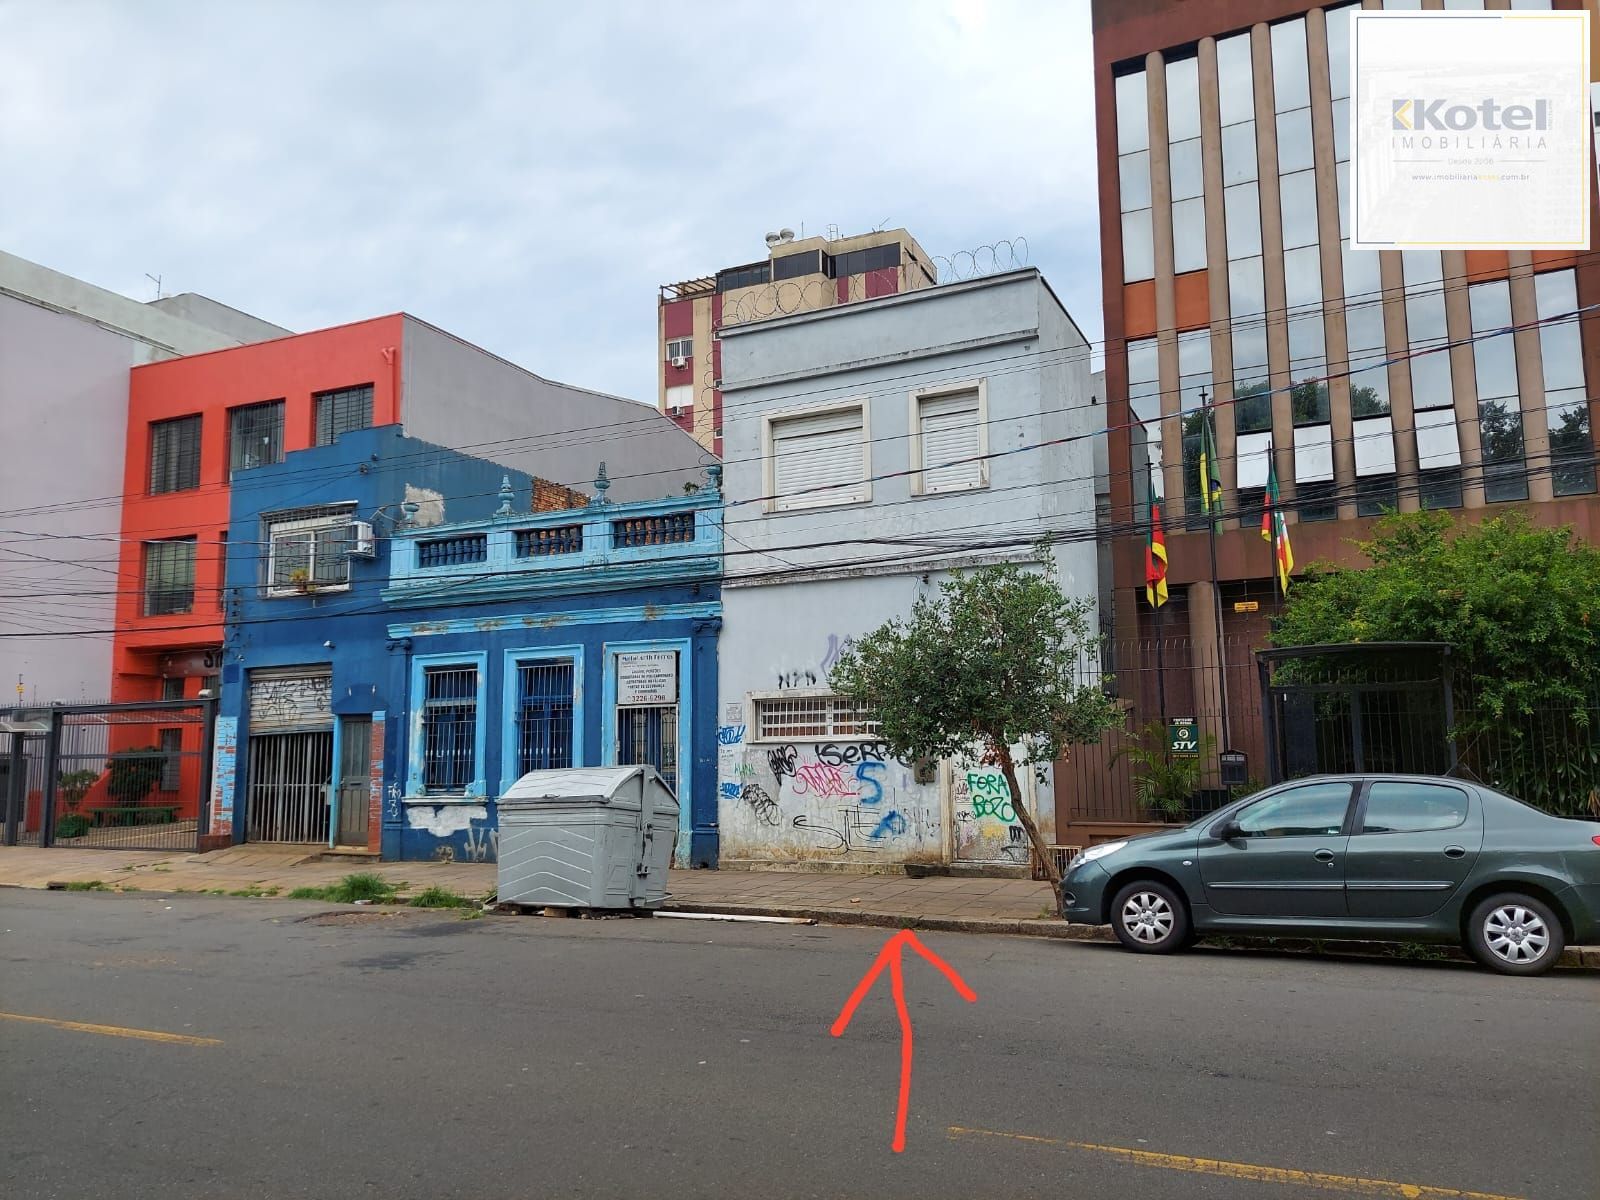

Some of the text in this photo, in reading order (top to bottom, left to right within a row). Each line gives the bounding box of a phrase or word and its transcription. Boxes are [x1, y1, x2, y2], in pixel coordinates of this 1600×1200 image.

[1171, 741, 1197, 750] STV
[967, 773, 1010, 797] FORA
[973, 794, 1017, 823] BOZO
